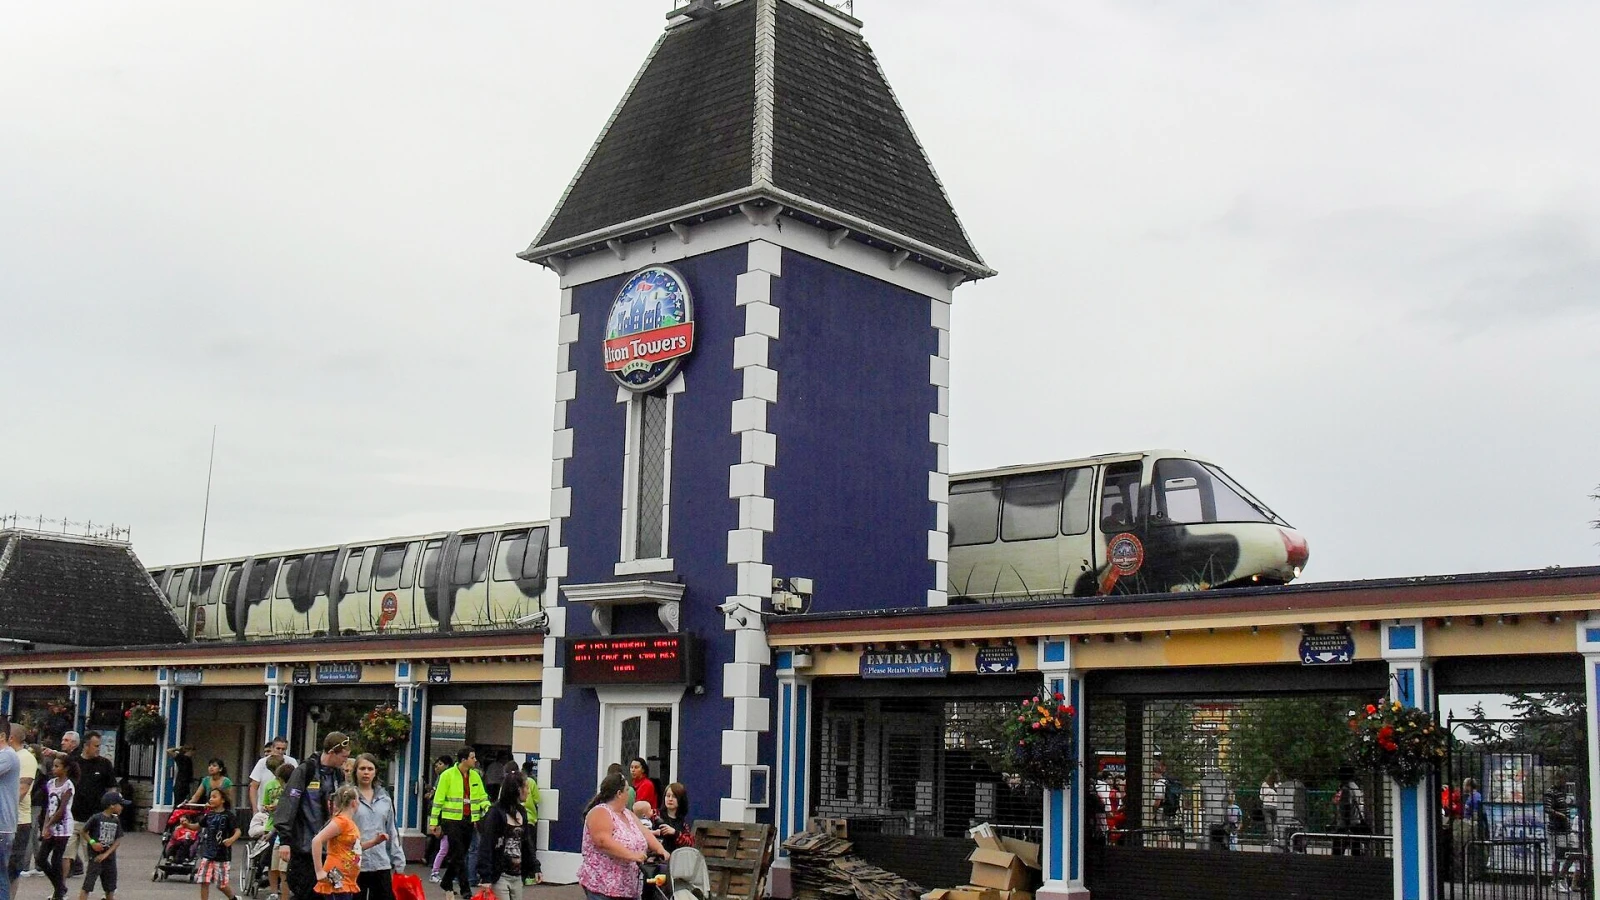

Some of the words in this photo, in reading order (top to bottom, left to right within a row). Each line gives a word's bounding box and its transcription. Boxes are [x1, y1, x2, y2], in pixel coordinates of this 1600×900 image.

[605, 346, 629, 363] Alton
[629, 335, 687, 357] Towers
[624, 362, 650, 373] RESORT
[867, 652, 942, 665] ENTRANCE
[320, 665, 357, 673] ENTRANCE
[921, 665, 939, 673] Ticket
